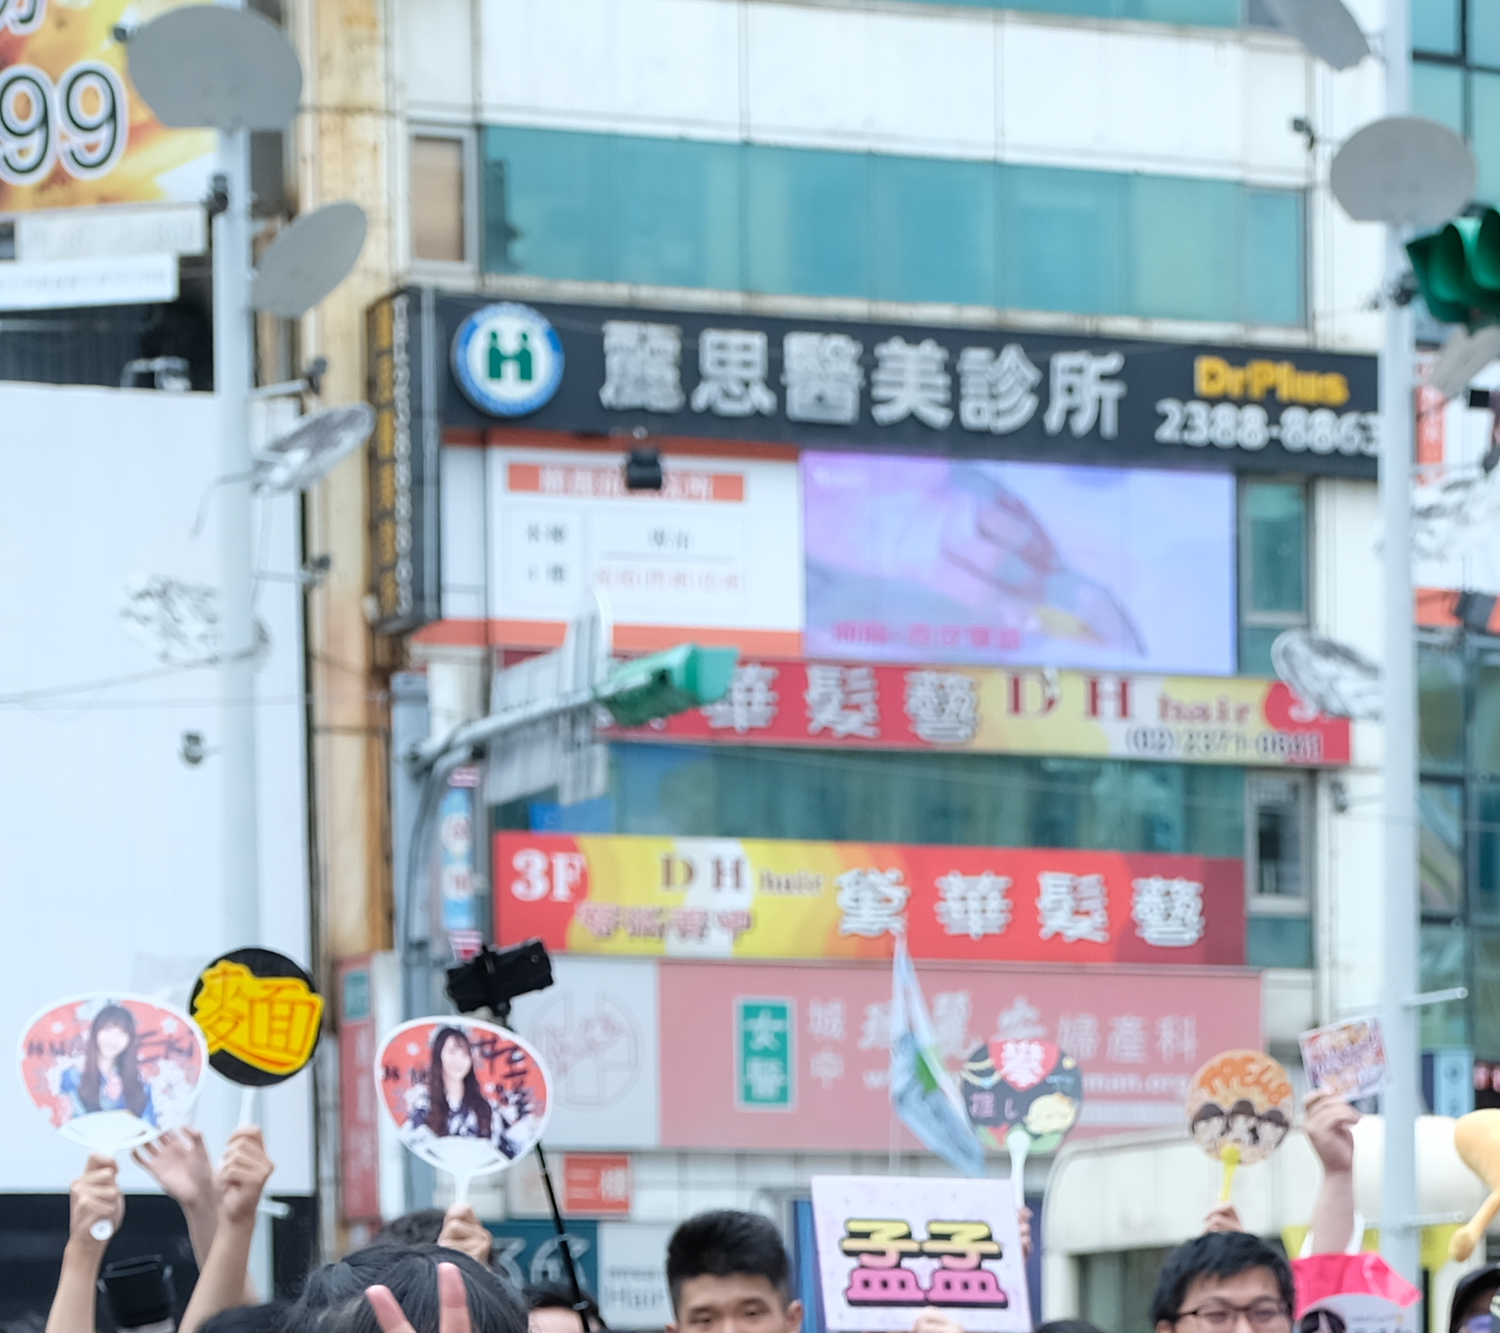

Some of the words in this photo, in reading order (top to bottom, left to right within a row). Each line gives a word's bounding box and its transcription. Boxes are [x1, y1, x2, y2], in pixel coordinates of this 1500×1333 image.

[600, 320, 1125, 438] 麗思醫美診所
[1158, 696, 1254, 724] hair
[510, 848, 586, 902] 3F
[760, 868, 824, 896] hair
[1057, 1016, 1198, 1064] 婦產科
